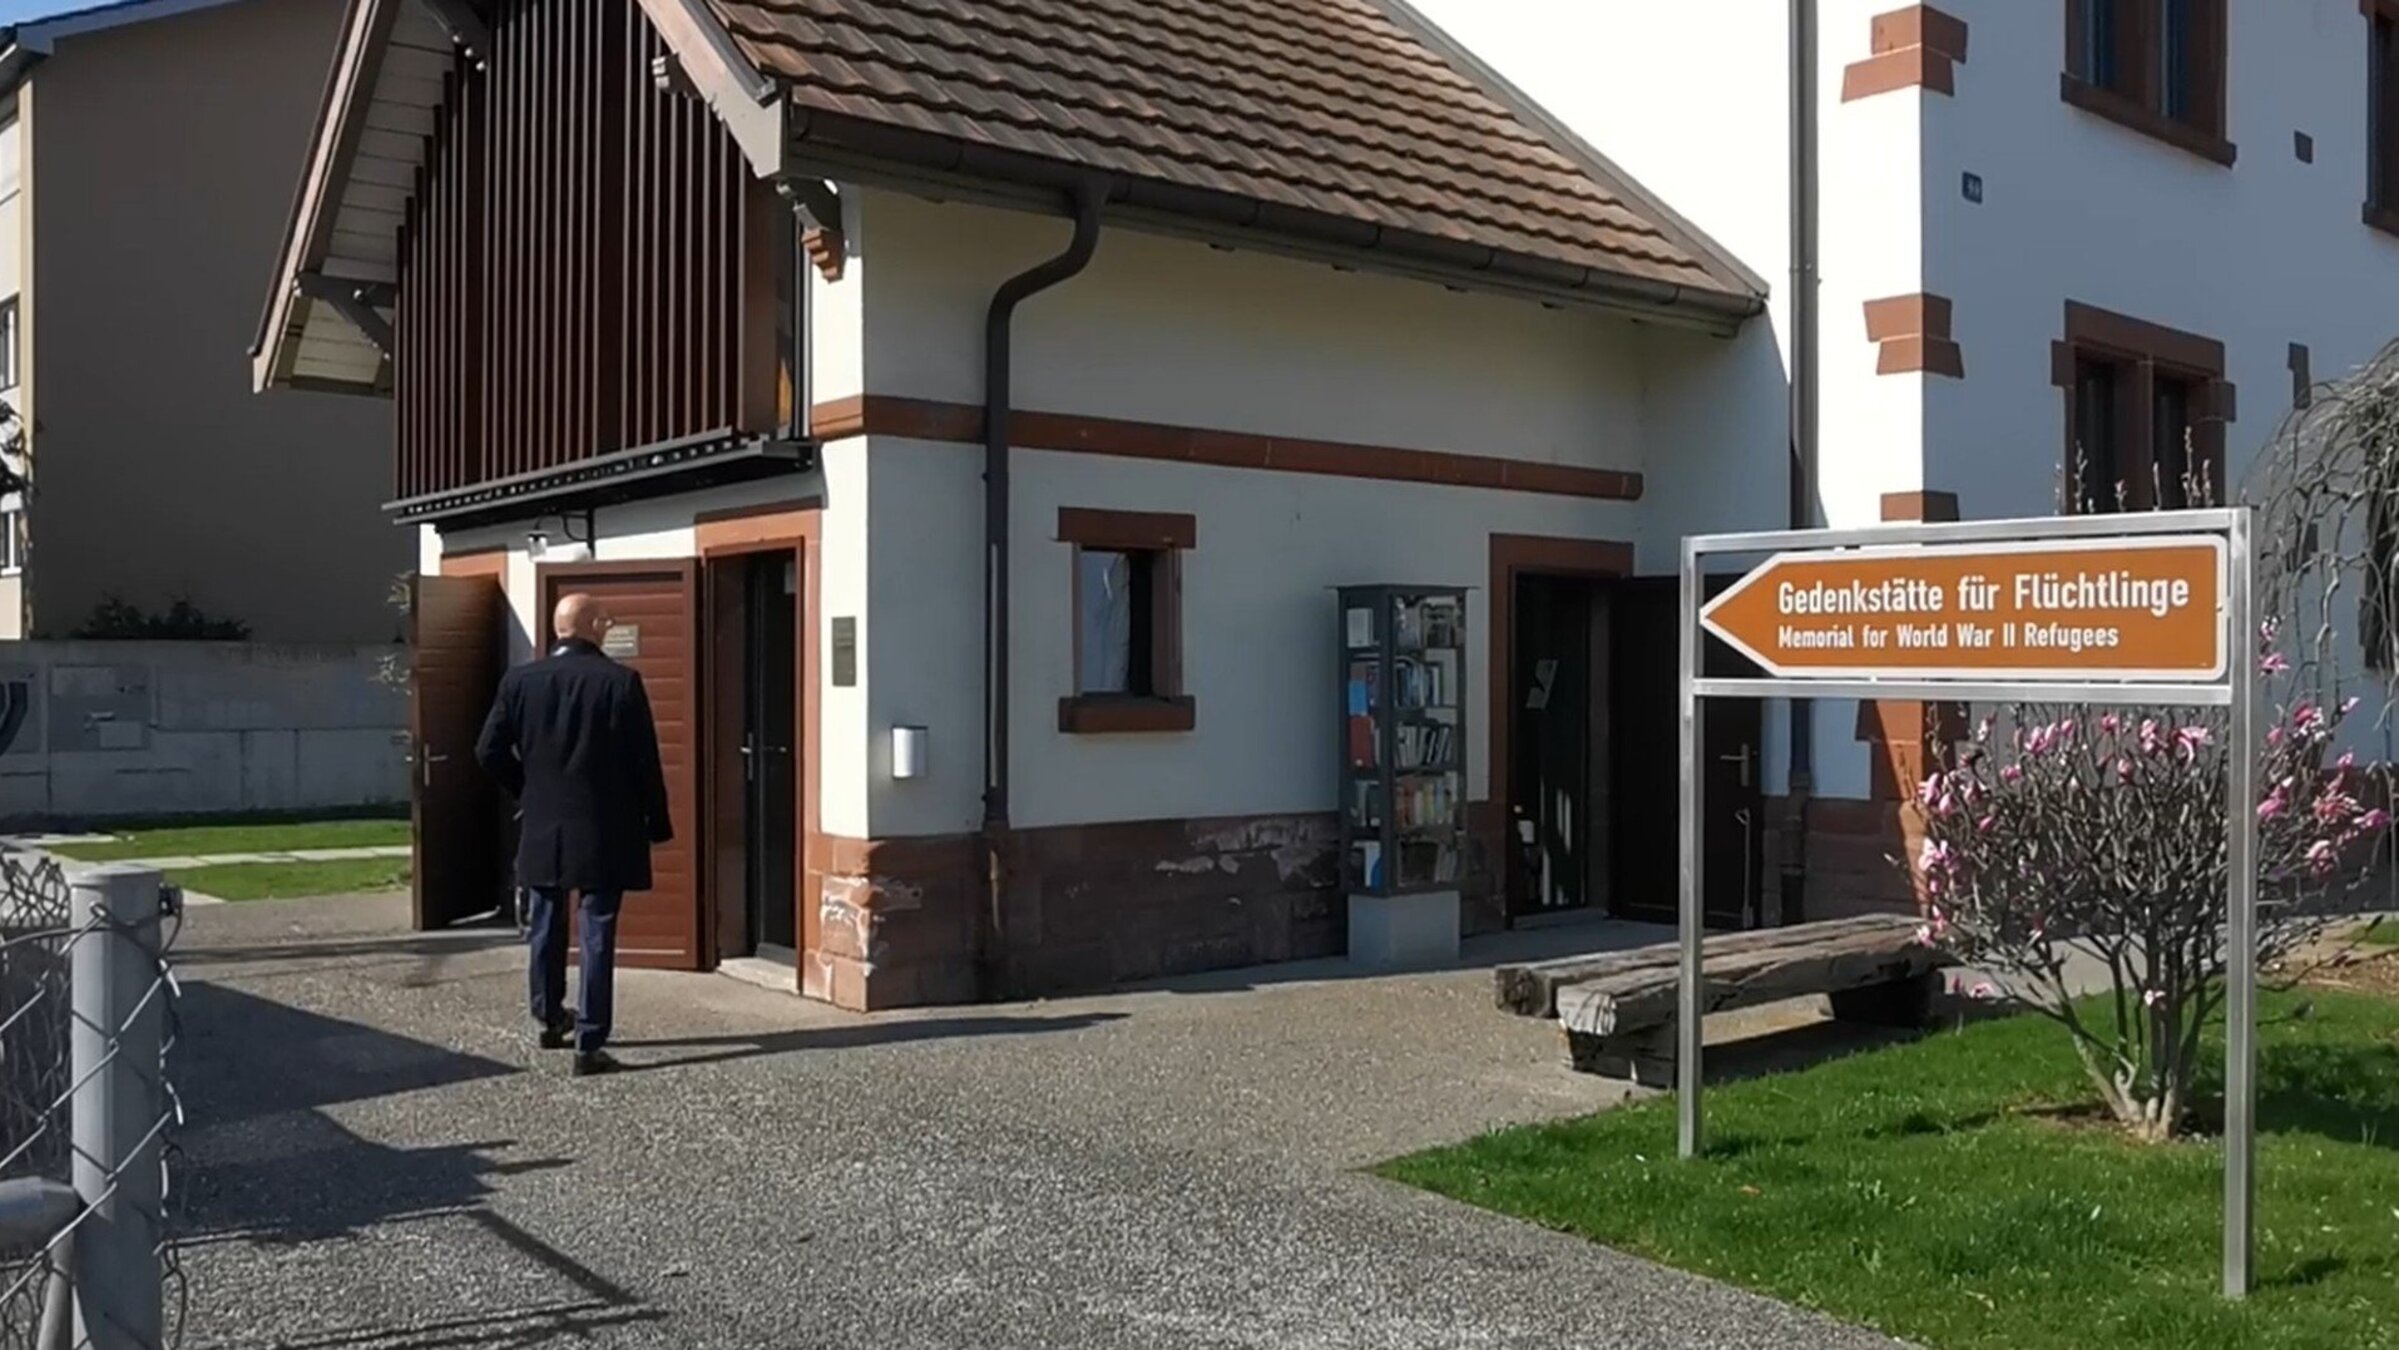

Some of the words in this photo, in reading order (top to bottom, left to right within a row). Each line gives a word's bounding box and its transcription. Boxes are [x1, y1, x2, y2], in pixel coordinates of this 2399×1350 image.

[1778, 577, 1944, 614] Gedenkstätte
[1957, 575, 2001, 610] für
[2014, 570, 2190, 618] Flüchtlinge
[1778, 624, 1855, 648] Memorial
[1862, 624, 1889, 648] for
[1896, 623, 1949, 648] World
[1956, 622, 1995, 647] War
[2002, 622, 2016, 647] II
[2023, 621, 2119, 653] Refugees
